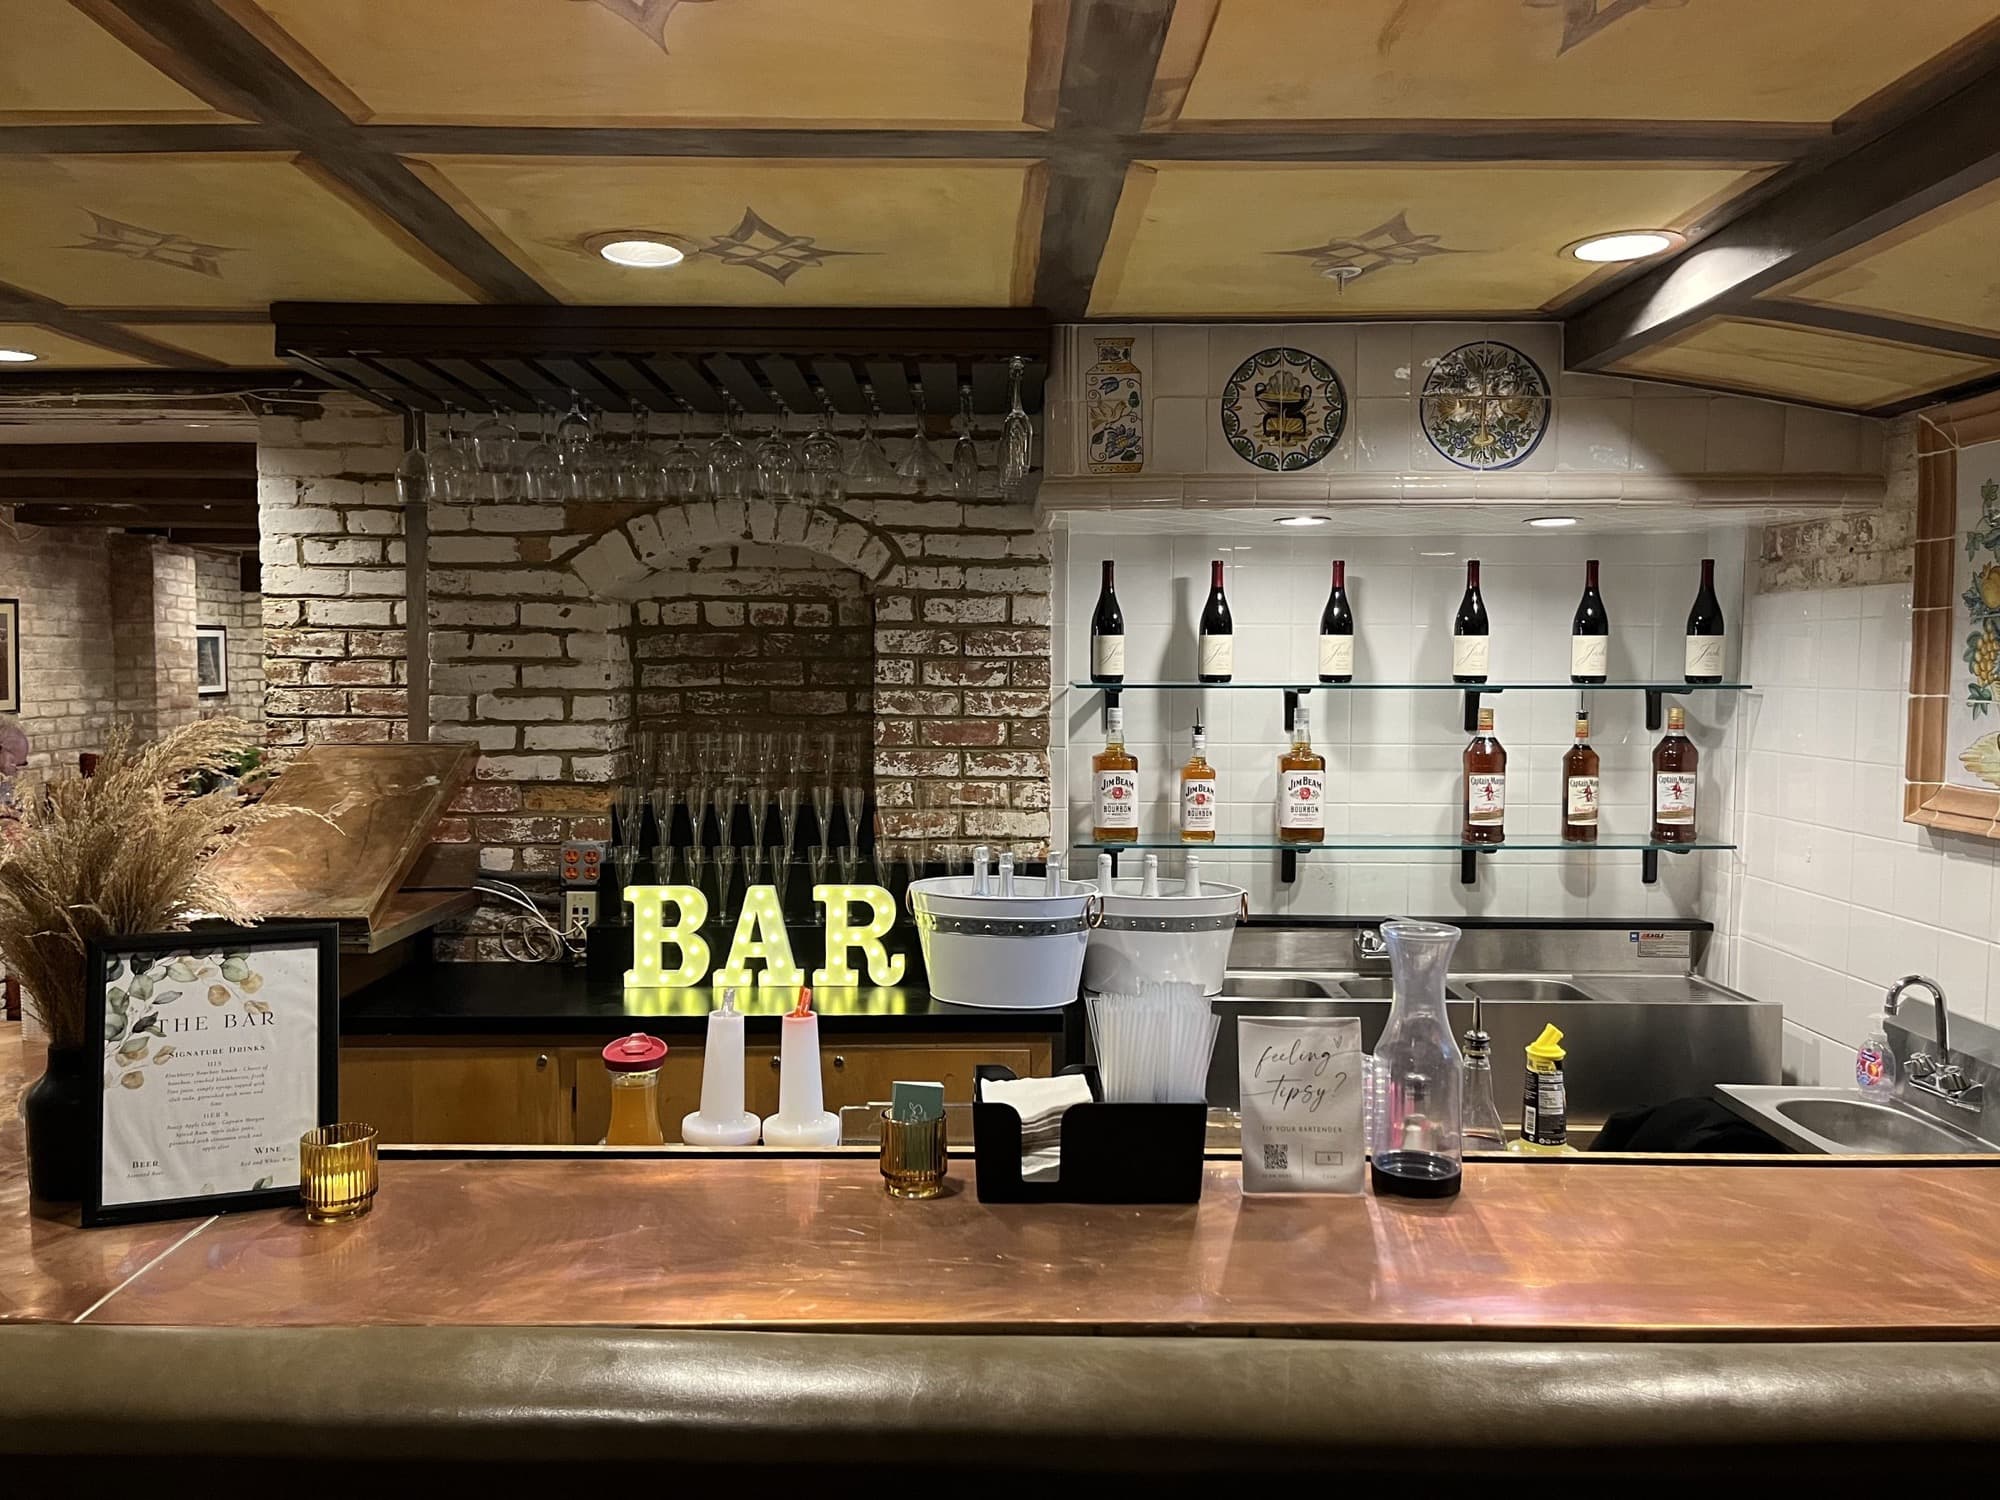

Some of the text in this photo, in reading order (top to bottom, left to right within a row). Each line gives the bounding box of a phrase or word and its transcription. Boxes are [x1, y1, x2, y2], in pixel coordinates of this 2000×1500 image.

[1101, 775, 1134, 790] JIM BEAM
[1288, 776, 1322, 791] JIM BEAM
[1103, 805, 1131, 813] BOURBON
[1187, 809, 1212, 817] BOURBON
[1290, 805, 1319, 813] BOURBON
[622, 884, 905, 988] BAR
[159, 1011, 275, 1033] THE BAR
[168, 1045, 266, 1058] SIGNATURE DRINKS
[1254, 1039, 1338, 1078] feeling
[1258, 1072, 1347, 1112] tipsy?
[1275, 1125, 1297, 1133] YOUR
[1298, 1125, 1343, 1133] BARTENDER
[254, 1146, 281, 1154] WINE
